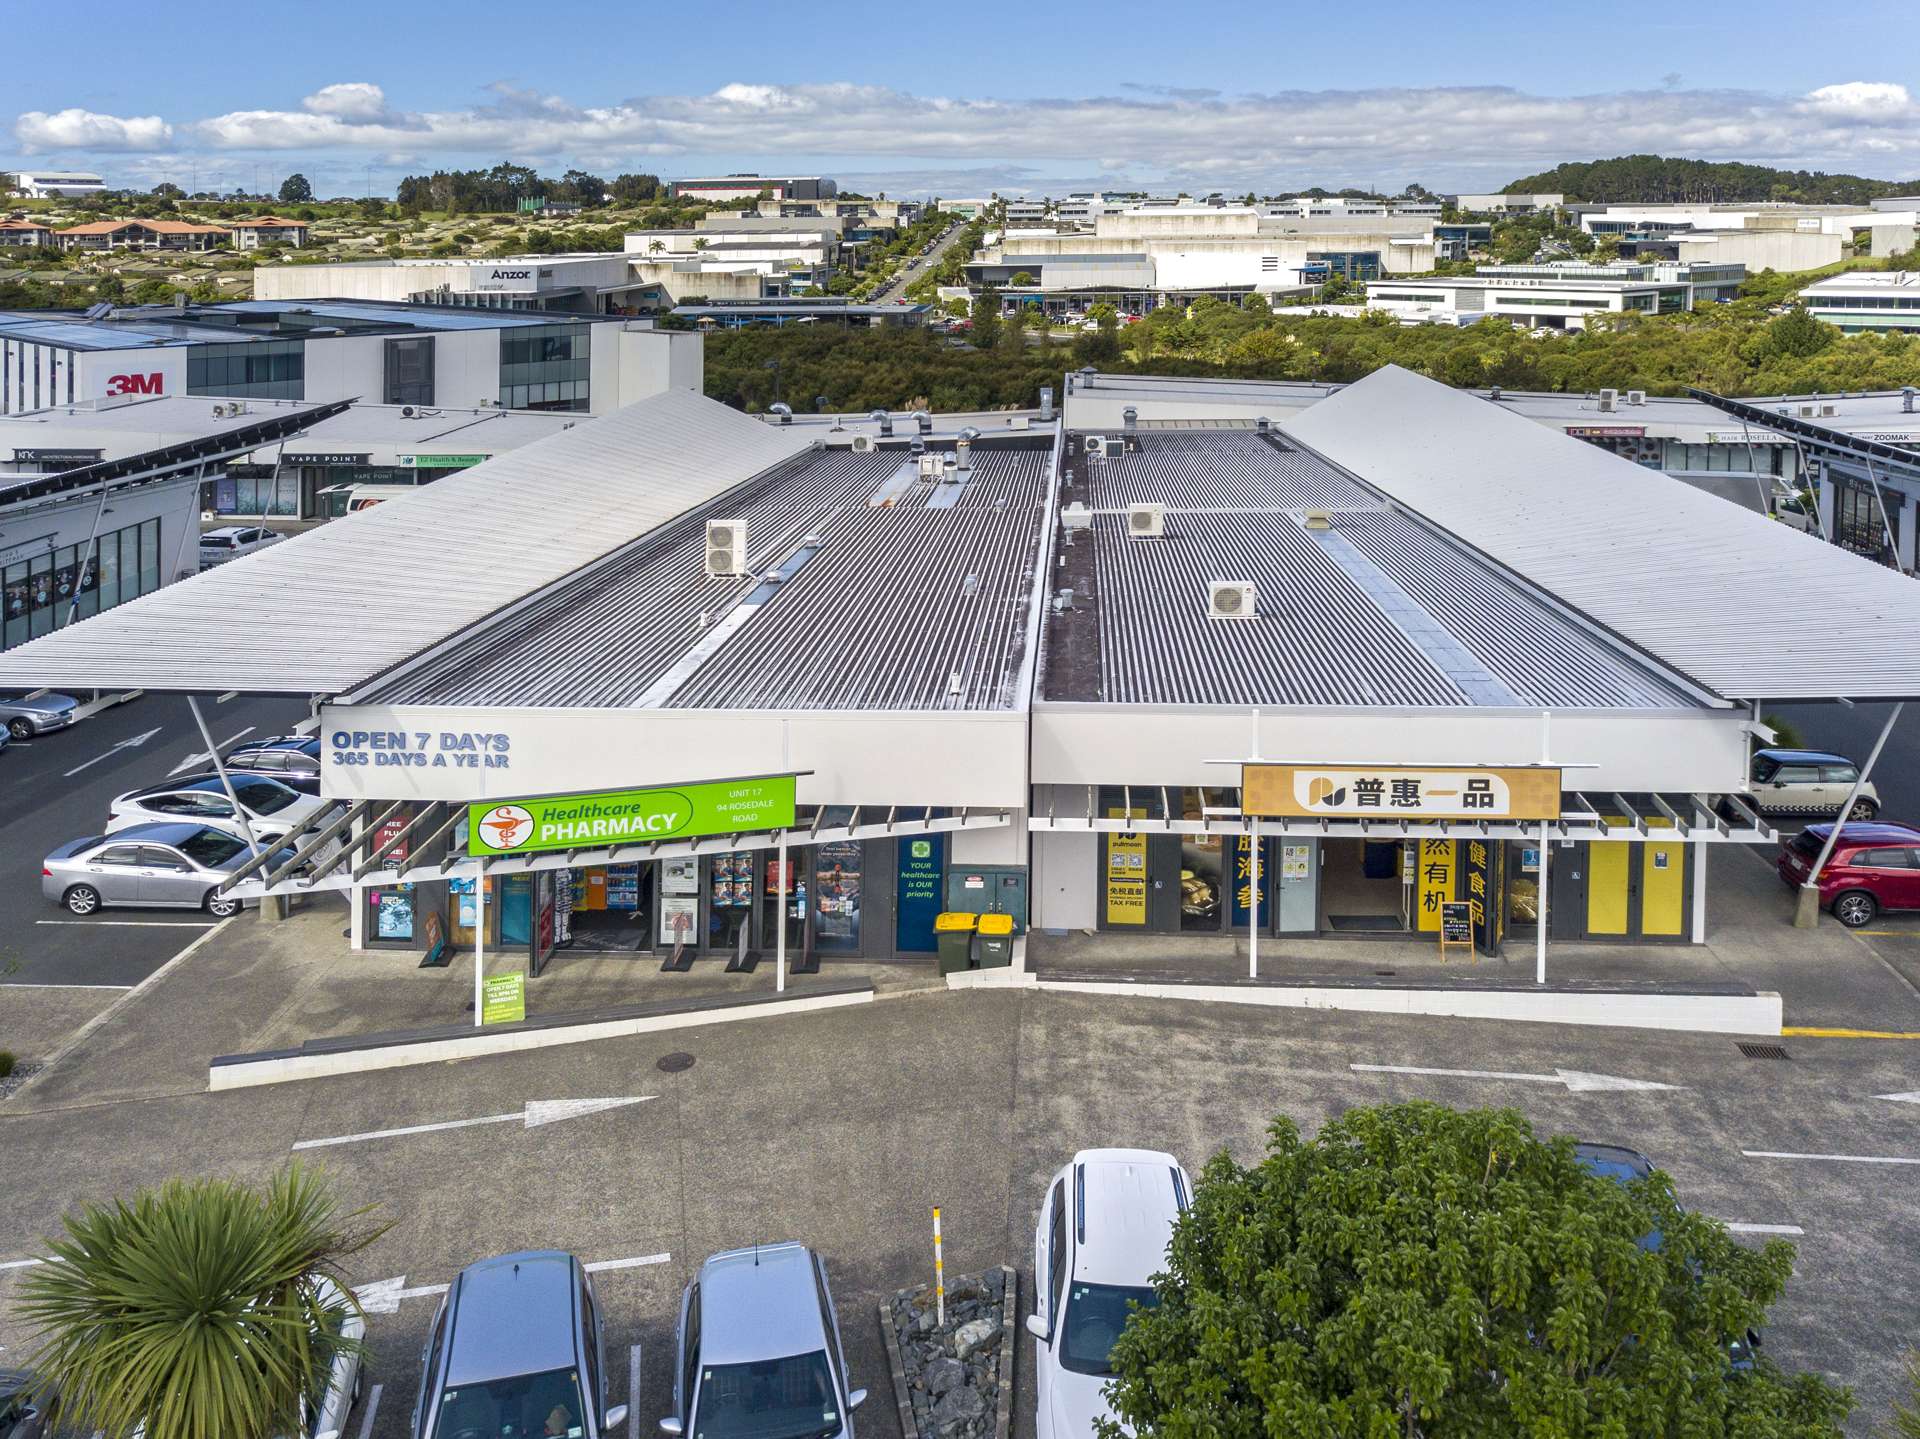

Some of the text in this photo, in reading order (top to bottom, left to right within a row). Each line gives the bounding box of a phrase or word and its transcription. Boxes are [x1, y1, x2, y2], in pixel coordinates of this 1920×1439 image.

[106, 373, 163, 396] 3M
[332, 731, 511, 751] OPEN 7 DAYS
[332, 751, 510, 768] 365 DAYS A YEAR
[729, 788, 763, 798] UNIT 17
[1352, 778, 1495, 809] 普惠一品
[542, 803, 641, 821] Healthcare
[729, 800, 775, 810] ROSEDALE
[541, 812, 678, 841] PHARMACY
[733, 813, 758, 823] ROAD
[1424, 838, 1450, 913] 然有机
[906, 890, 934, 898] priority
